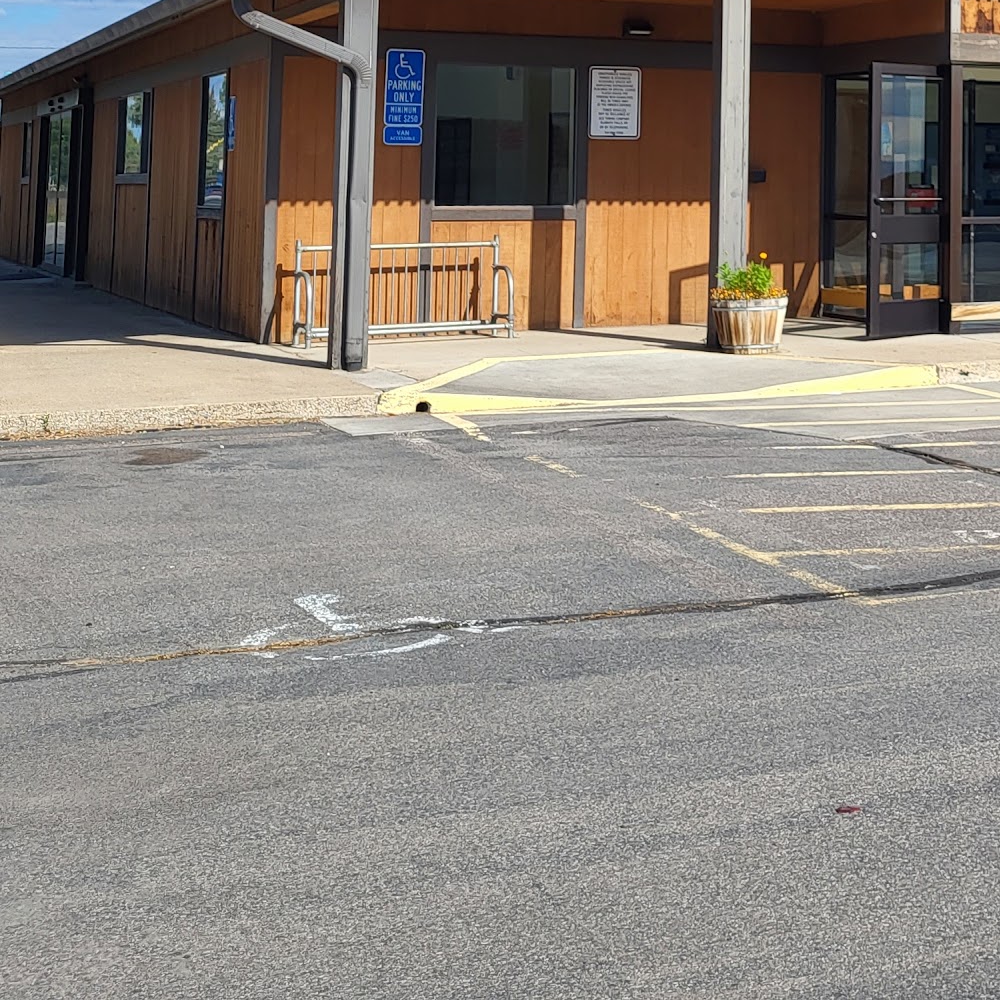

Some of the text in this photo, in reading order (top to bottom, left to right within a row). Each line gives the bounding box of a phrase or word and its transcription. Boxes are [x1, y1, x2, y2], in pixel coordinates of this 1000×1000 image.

[388, 80, 421, 91] PARKING
[394, 92, 414, 102] ONLY
[403, 115, 418, 123] $250
